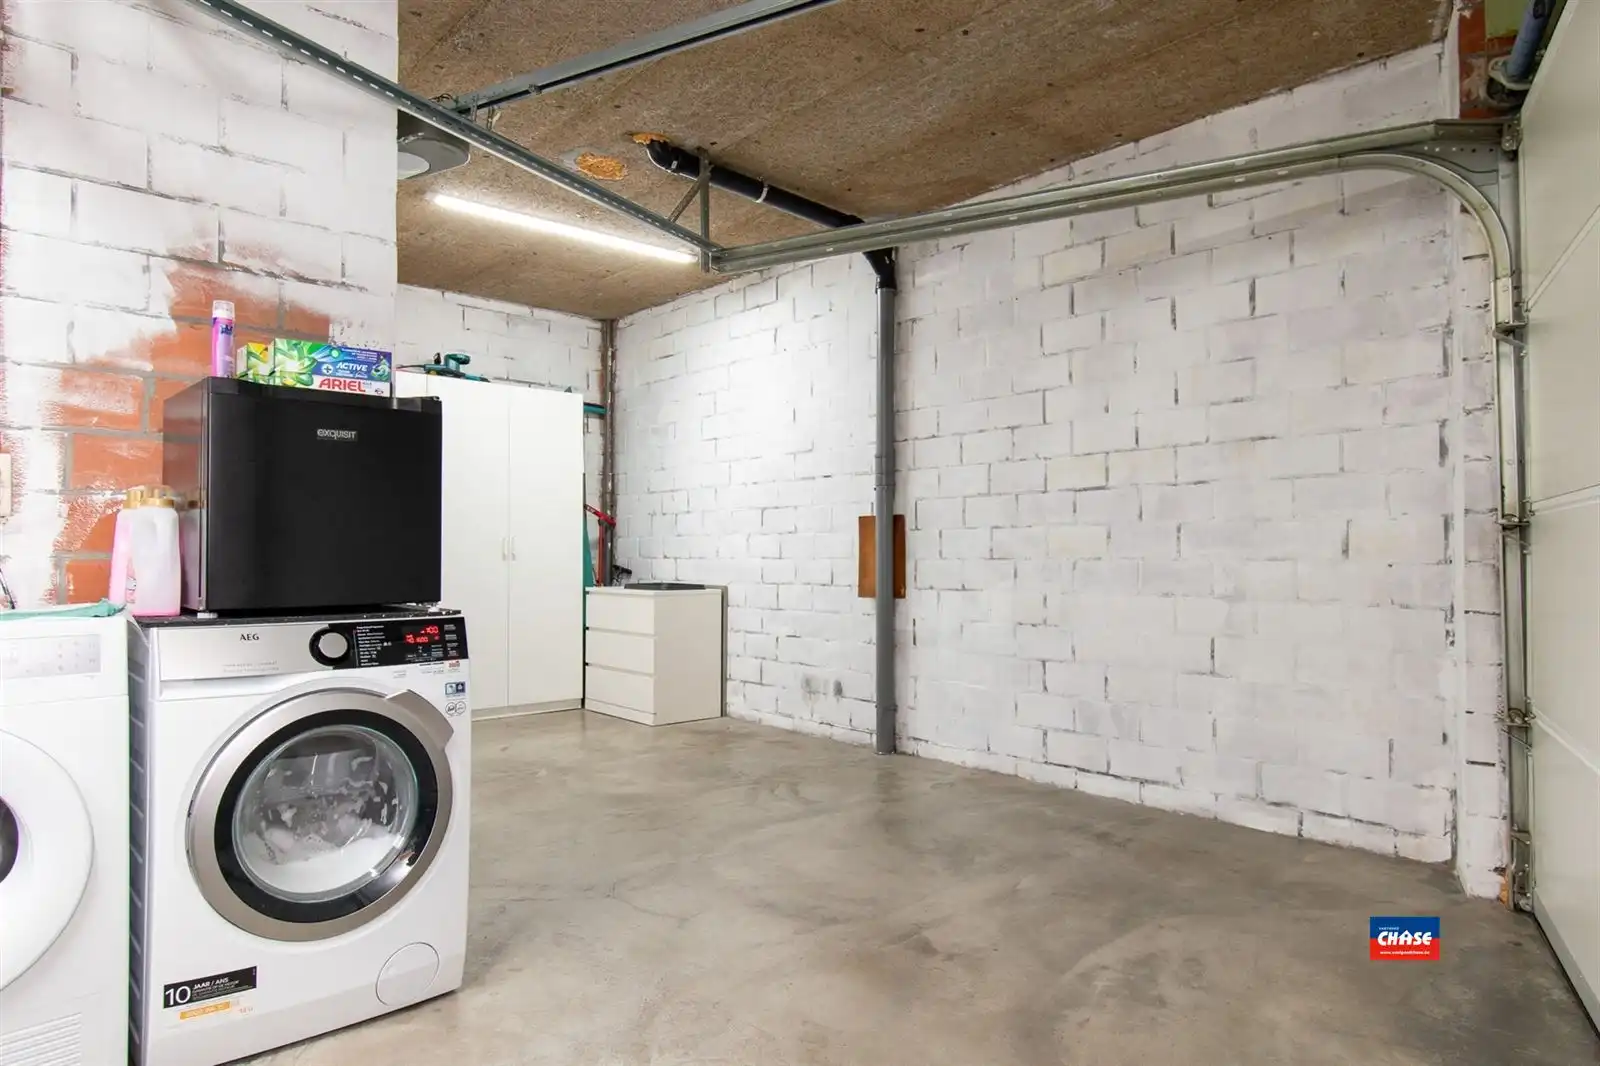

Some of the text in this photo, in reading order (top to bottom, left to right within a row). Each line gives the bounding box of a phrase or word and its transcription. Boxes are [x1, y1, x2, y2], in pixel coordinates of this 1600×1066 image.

[336, 362, 369, 372] ACTIVE
[319, 378, 366, 393] ARIEL
[240, 633, 260, 641] AEG
[193, 981, 211, 990] JAAR
[215, 977, 229, 985] ANS
[165, 985, 191, 1006] 10
